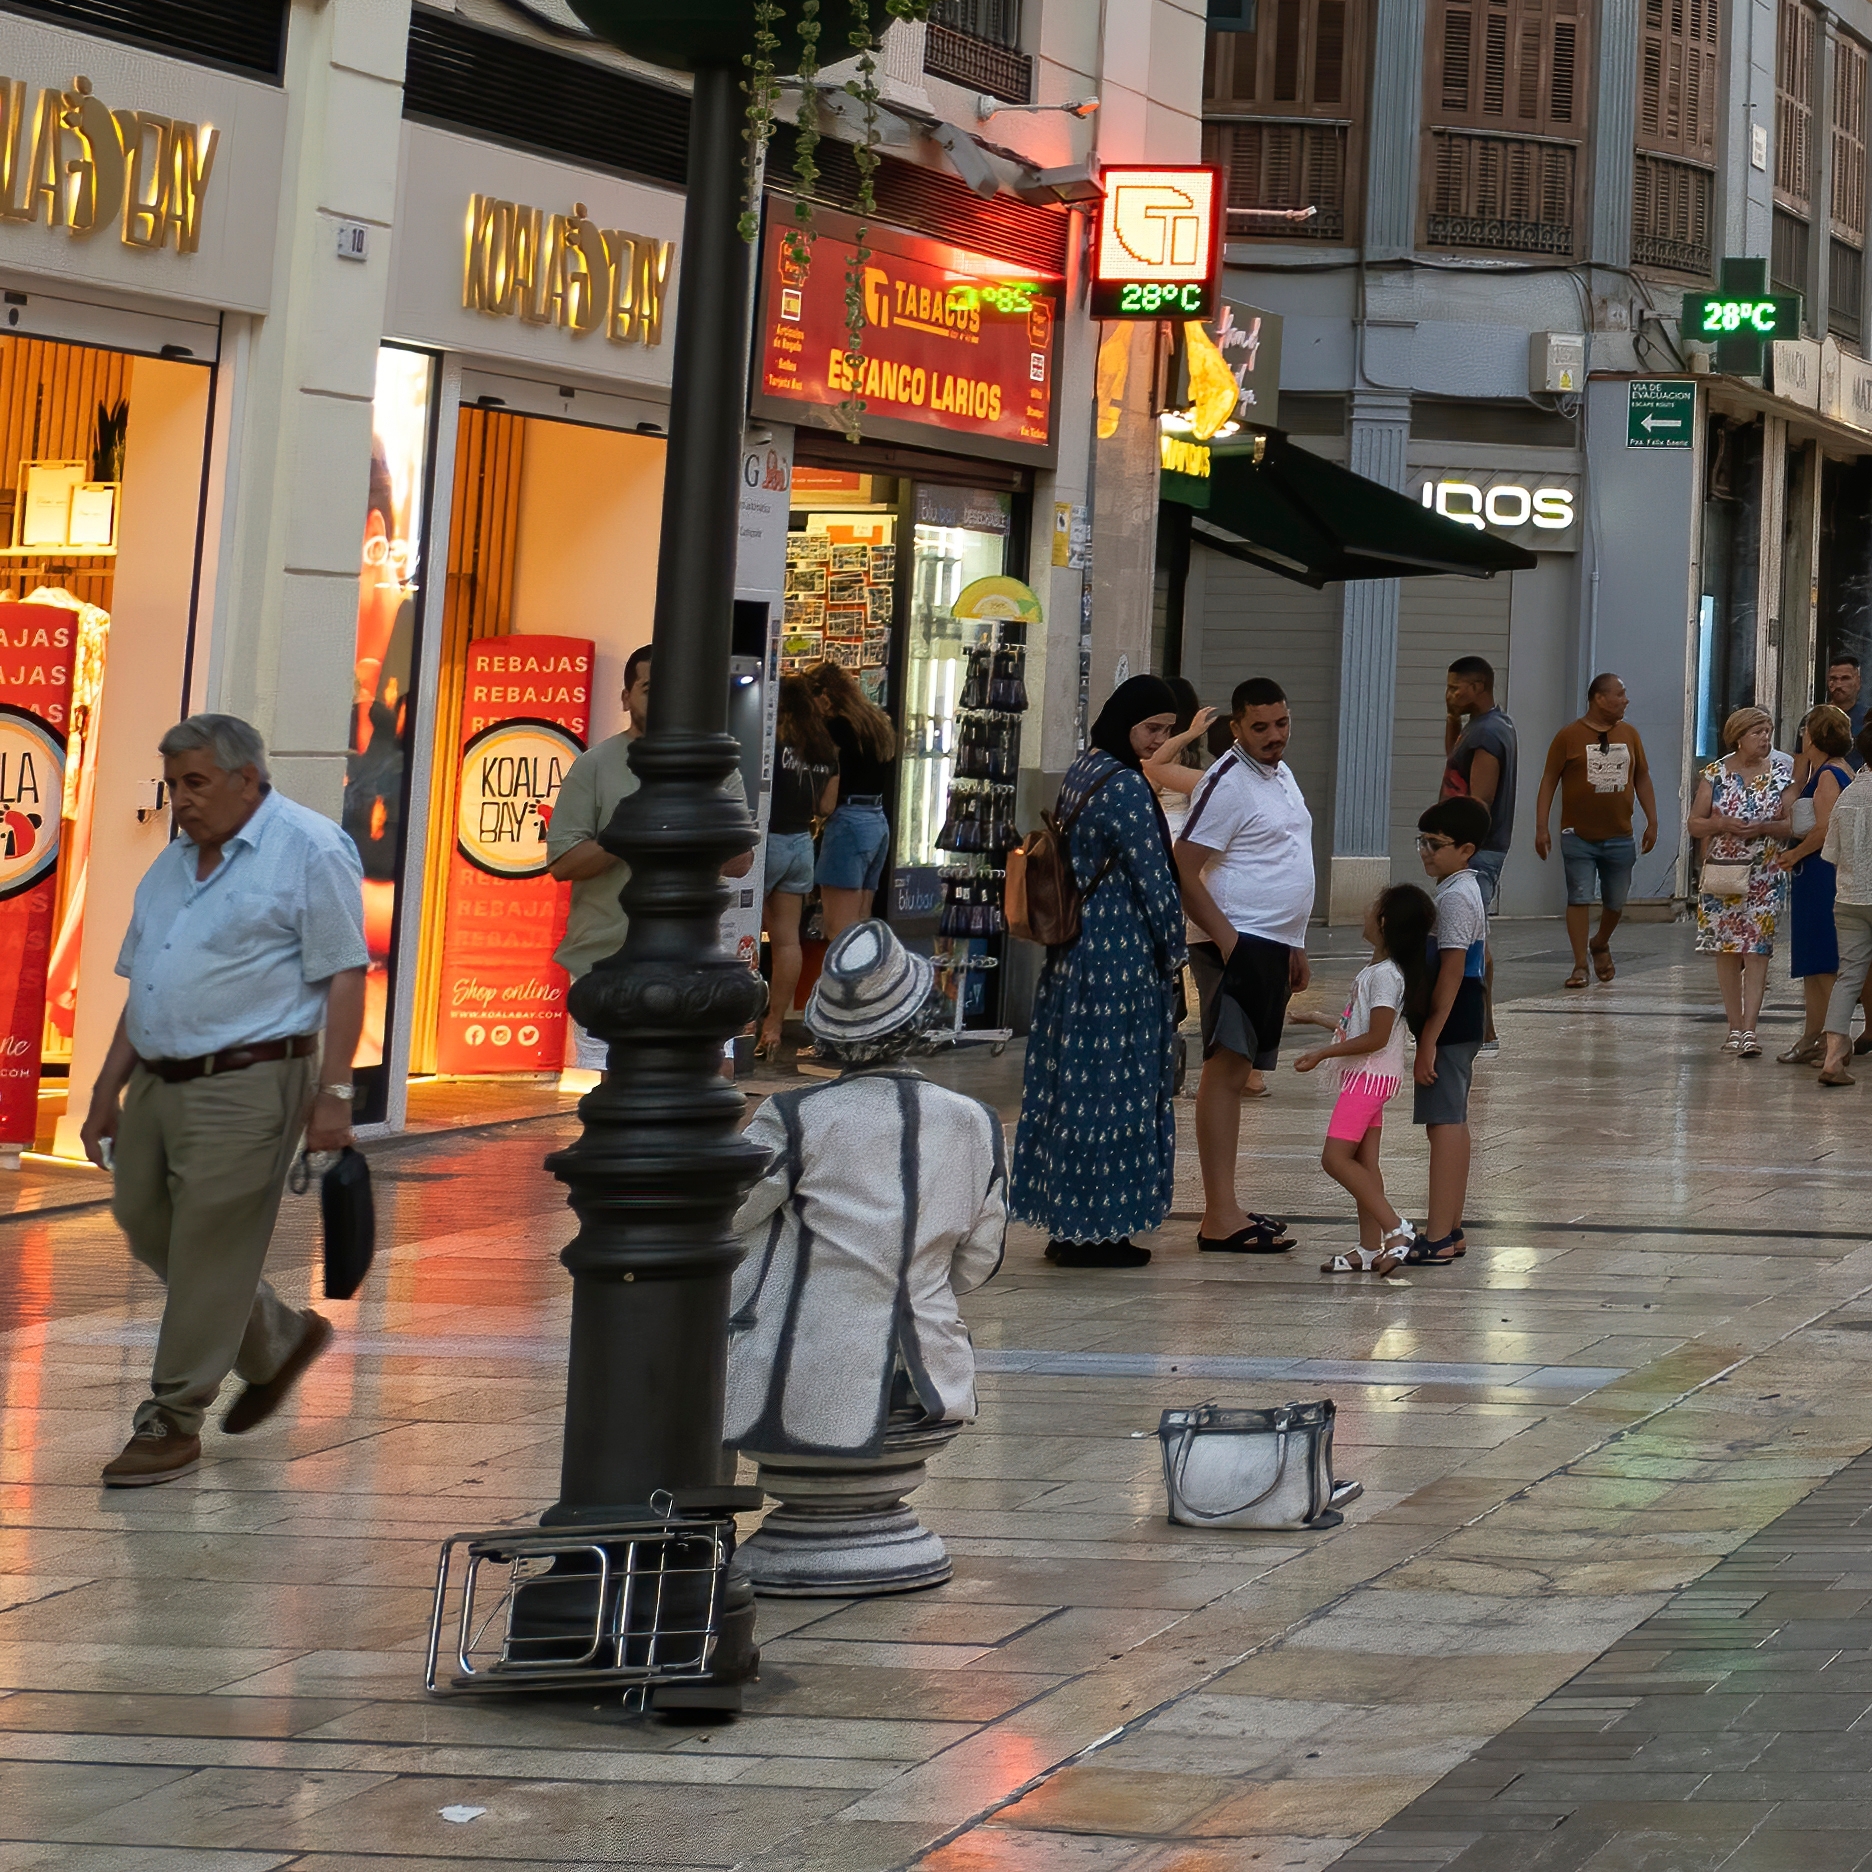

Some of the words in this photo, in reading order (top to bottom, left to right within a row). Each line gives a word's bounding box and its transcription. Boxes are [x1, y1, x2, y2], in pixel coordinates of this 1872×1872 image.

[462, 192, 569, 330] KOALA
[606, 229, 677, 347] BAY
[895, 280, 980, 333] TABACOS
[827, 348, 926, 406] ESTANCO
[930, 371, 1002, 422] LARIOS
[1649, 383, 1662, 392] DE
[1422, 480, 1575, 531] IQOS
[476, 656, 588, 673] REBAJAS
[473, 686, 587, 704] REBAJAS
[482, 756, 564, 798] KOALA
[479, 801, 530, 844] BAY
[452, 977, 498, 1008] Shop
[501, 977, 561, 1001] online
